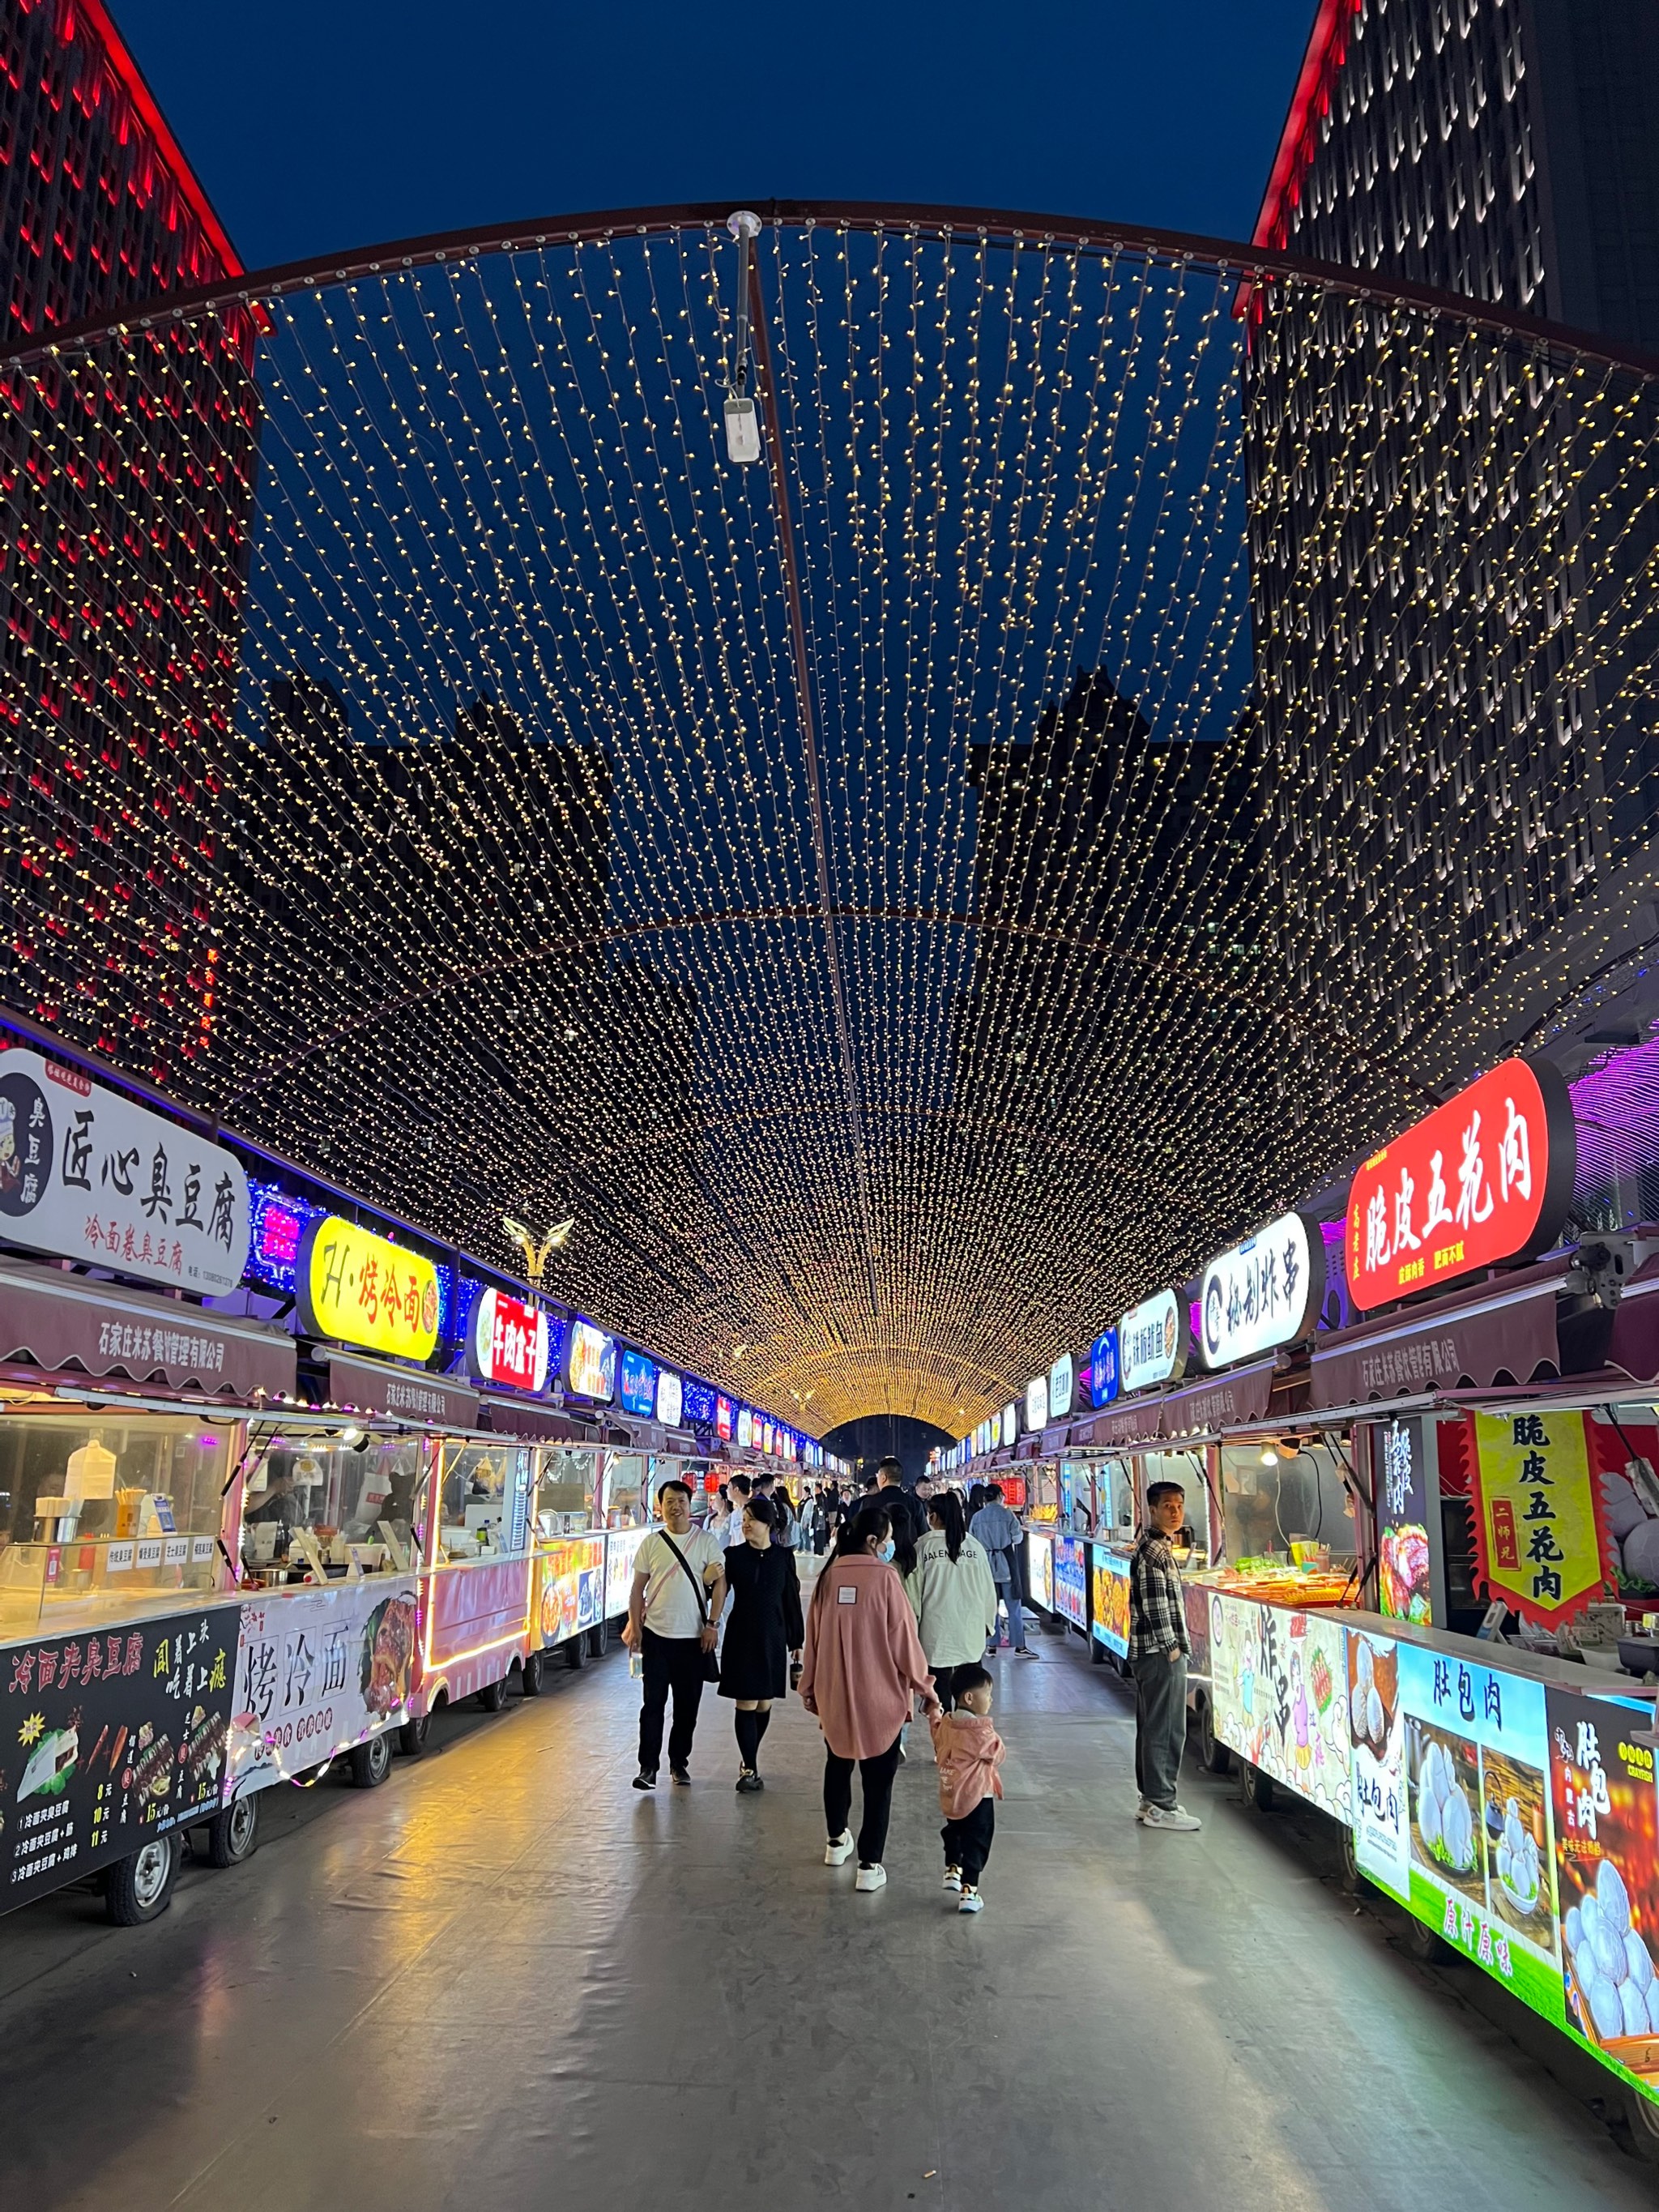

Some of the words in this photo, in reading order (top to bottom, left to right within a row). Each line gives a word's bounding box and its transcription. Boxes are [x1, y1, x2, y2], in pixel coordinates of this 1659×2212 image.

[20, 1097, 45, 1204] 臭豆腐
[62, 1109, 235, 1253] 匠心臭豆腐
[1366, 1097, 1531, 1272] 脆皮五花肉
[84, 1214, 183, 1276] 冷面卷臭豆腐
[493, 1314, 536, 1375] 牛肉盒子
[1495, 1507, 1515, 1561] 二师兄
[1512, 1415, 1565, 1601] 脆皮五花肉
[9, 1632, 143, 1694] 冷面夹臭豆腐
[244, 1624, 349, 1723] 烤冷面
[1434, 1659, 1502, 1732] 肚包肉
[1356, 1761, 1399, 1835] 肚包肉
[1576, 1721, 1611, 1840] 肚包肉
[1444, 1898, 1513, 1977] 原汁原味
